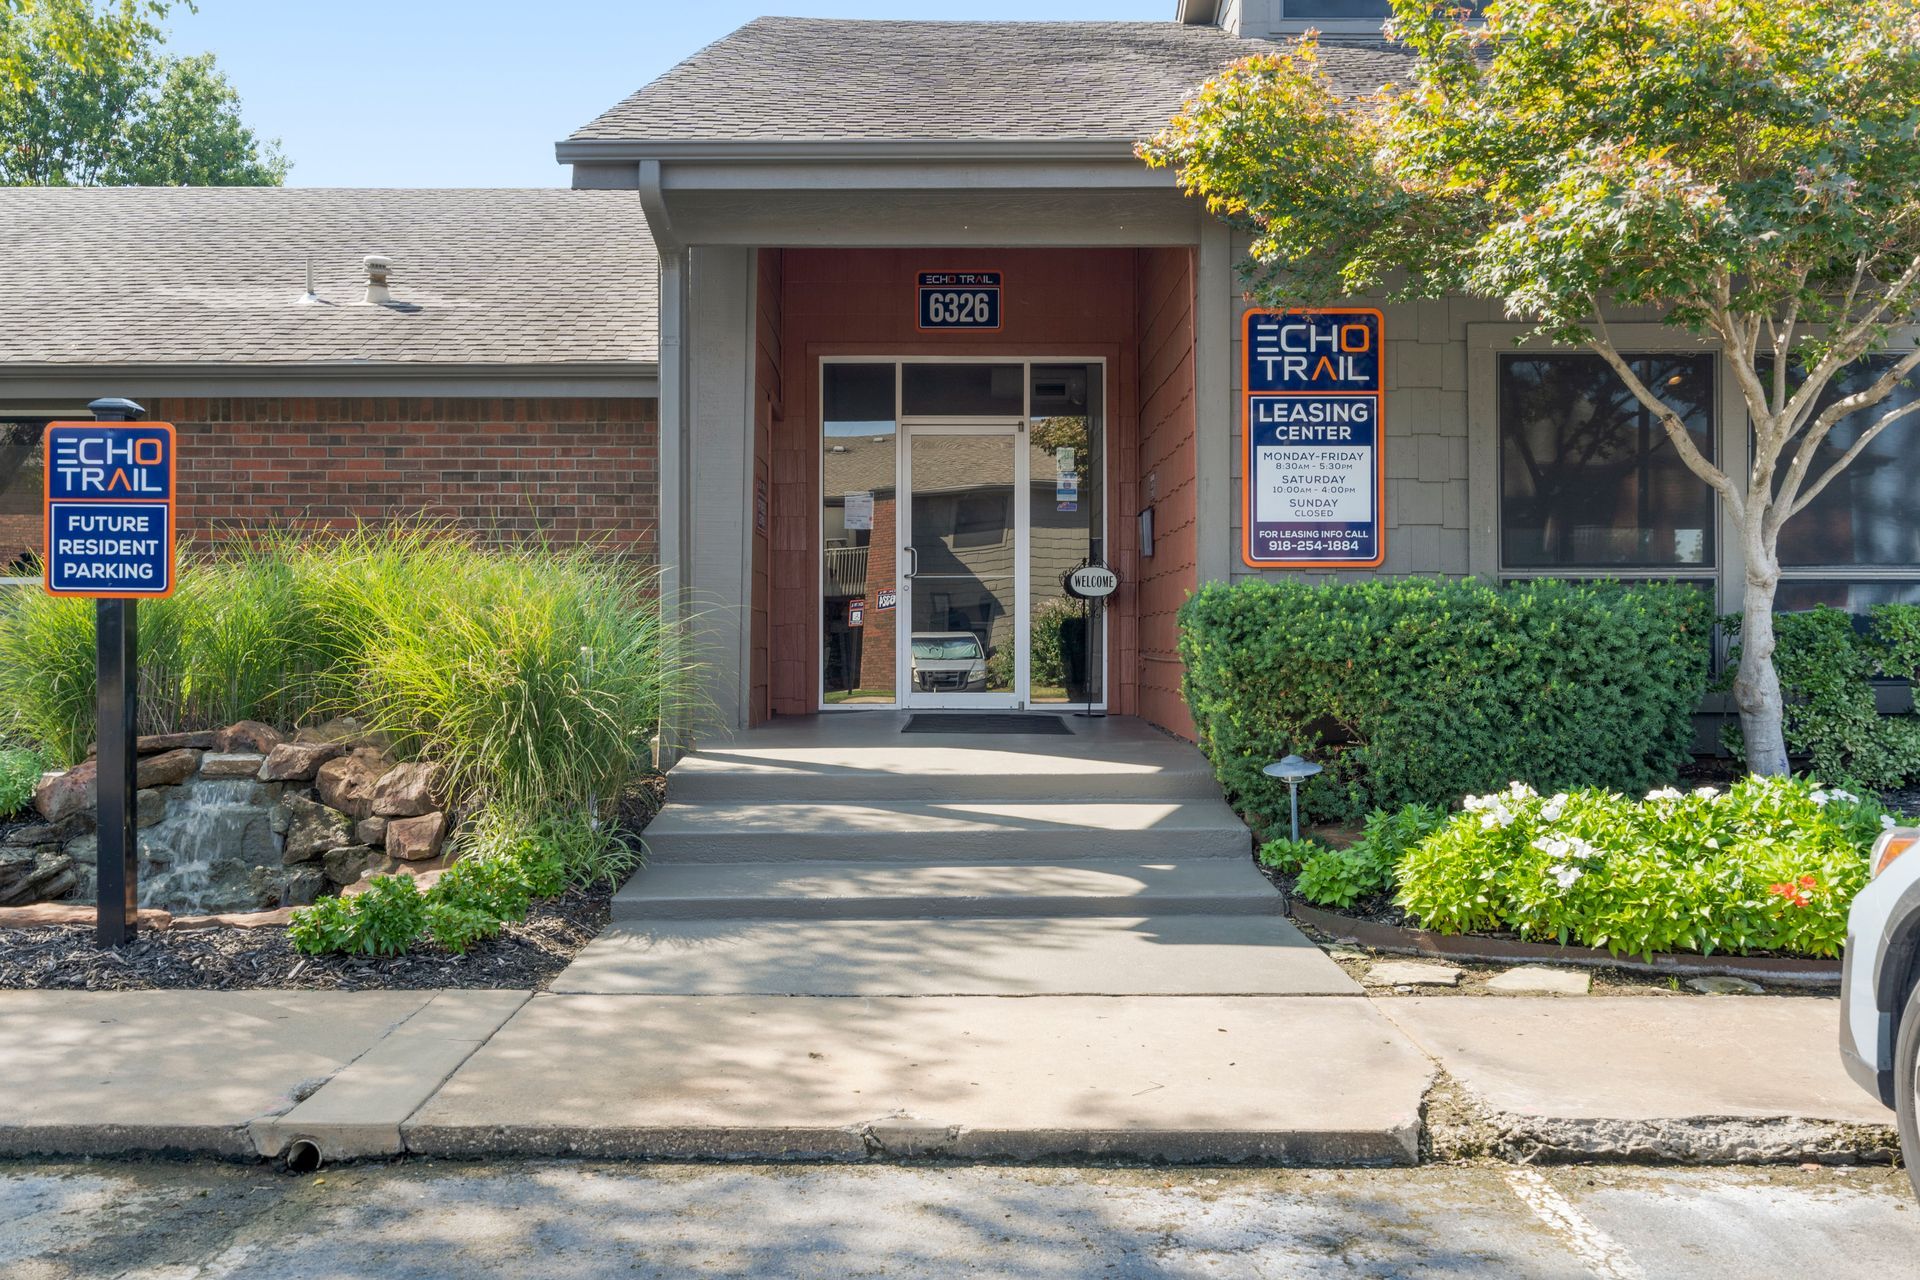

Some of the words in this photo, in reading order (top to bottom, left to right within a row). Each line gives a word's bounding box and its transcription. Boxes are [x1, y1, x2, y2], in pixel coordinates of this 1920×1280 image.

[926, 275, 956, 284] ECHO
[959, 275, 993, 284] TRAIL
[929, 292, 989, 323] 6326
[1257, 324, 1370, 353] ECHO
[1257, 355, 1370, 381] TRAIL
[1259, 403, 1368, 423] LEASING
[1275, 426, 1352, 440] CENTER
[57, 438, 162, 465] ECHO
[1263, 452, 1364, 461] MONDAY-FRIDAY
[57, 467, 162, 491] TRAIL
[1282, 475, 1346, 484] SATURDAY
[1289, 499, 1338, 508] SUNDAY
[68, 516, 149, 532] FUTURE
[1259, 530, 1278, 538] FOR
[1280, 530, 1320, 539] LEASING
[1321, 530, 1343, 538] INFO
[1344, 530, 1369, 538] CALL
[58, 539, 158, 556] RESIDENT
[1268, 540, 1360, 551] 918-254-1884
[63, 563, 154, 579] PARKING
[1074, 575, 1114, 588] WELCOME
